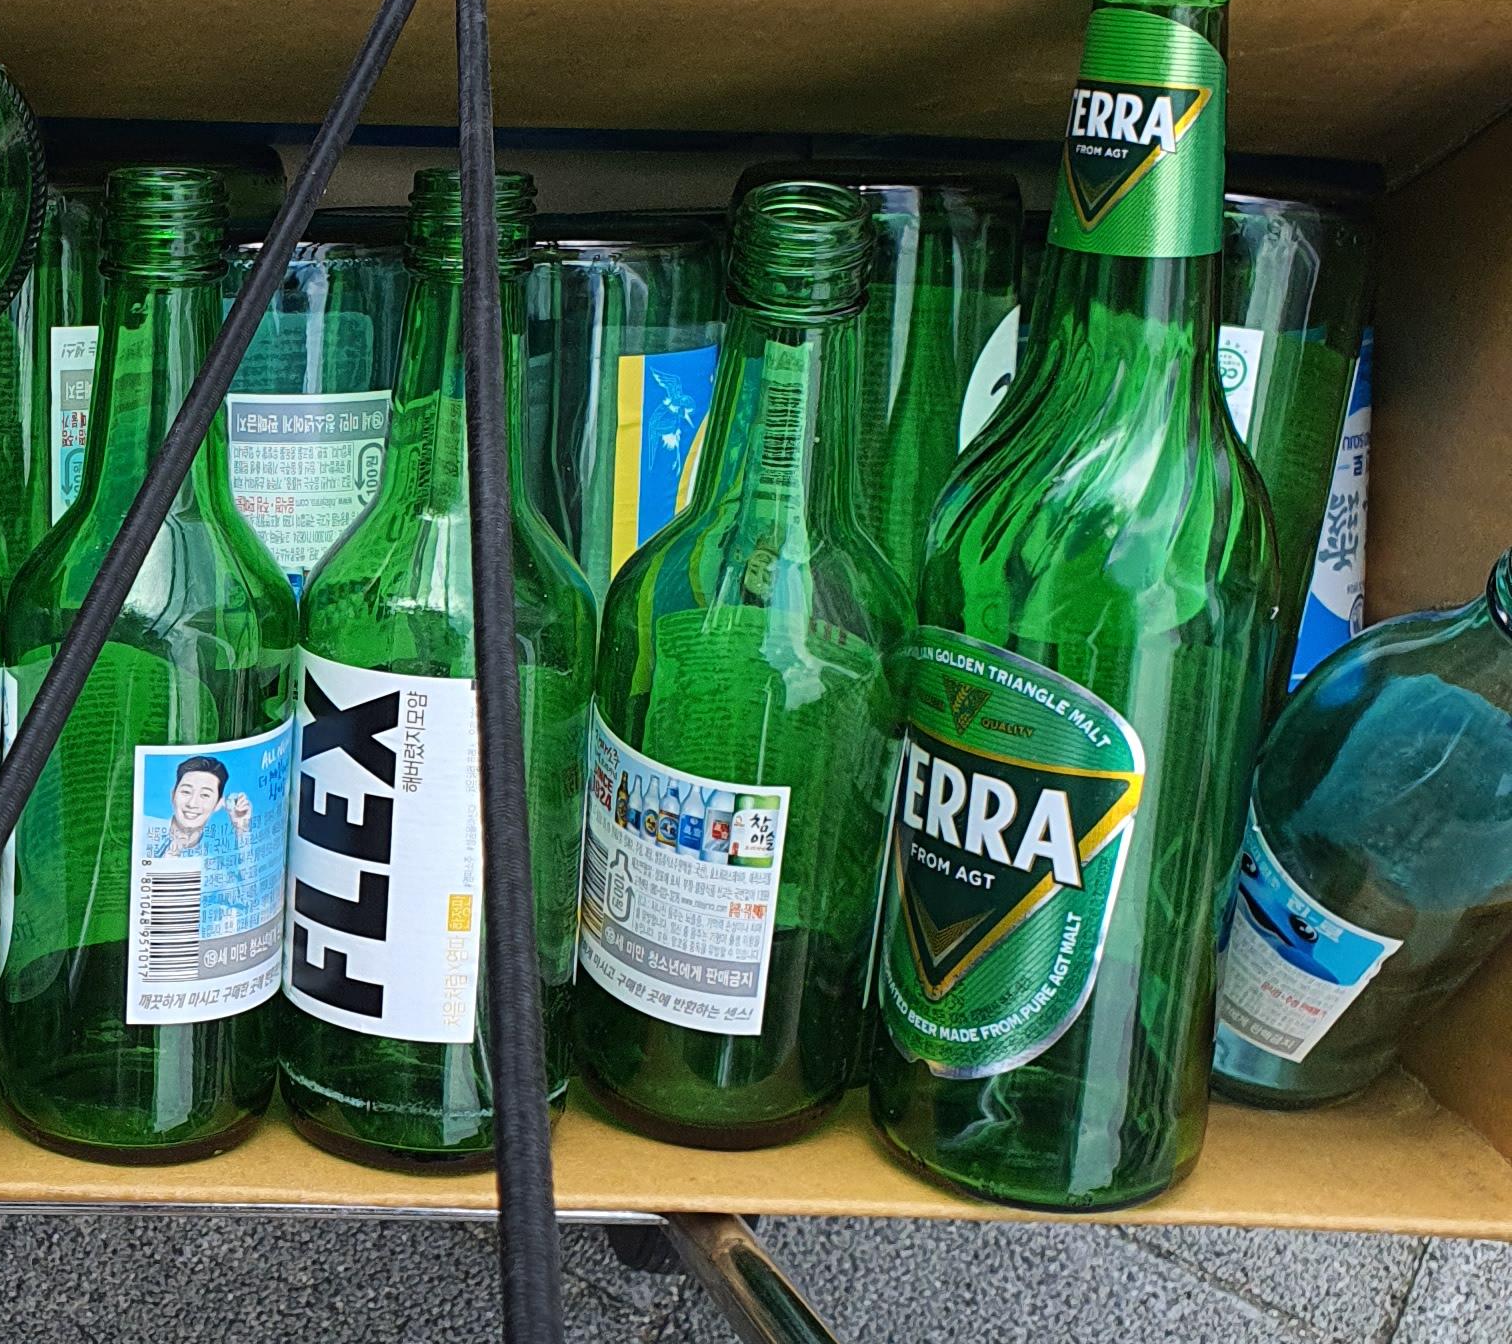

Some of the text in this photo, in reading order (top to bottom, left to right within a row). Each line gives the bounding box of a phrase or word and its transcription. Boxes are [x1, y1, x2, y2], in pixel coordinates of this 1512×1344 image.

[1067, 88, 1177, 154] ERRA
[1075, 144, 1129, 159] FROM AGT
[236, 412, 279, 433] 판매금지
[282, 413, 335, 433] 청소년에게
[935, 648, 986, 676] GOLDEN
[987, 665, 1072, 716] TRIANGLE
[1067, 708, 1113, 749] MALT
[401, 690, 429, 794] 해버렸지모얌
[980, 716, 1036, 738] QUALITY
[749, 812, 773, 832] 참
[900, 738, 1084, 891] ERRA
[291, 665, 401, 1019] FLEX
[750, 831, 775, 851] 이슬
[910, 842, 996, 890] FROM AGT
[139, 877, 152, 926] 801048
[138, 930, 150, 978] 951017
[230, 943, 248, 963] 미만
[626, 940, 645, 963] 미만
[648, 950, 702, 982] 청소년에게
[705, 967, 754, 988] 판매금지
[907, 910, 1083, 1043] BEER MADE FROM PURE AGT MALT
[138, 992, 187, 1011] 깨끗하게
[188, 988, 221, 1007] 마시고
[617, 972, 647, 997] 구매한
[646, 989, 671, 1007] 곳에
[673, 998, 720, 1020] 반환하는
[723, 1007, 754, 1022] 센스!
